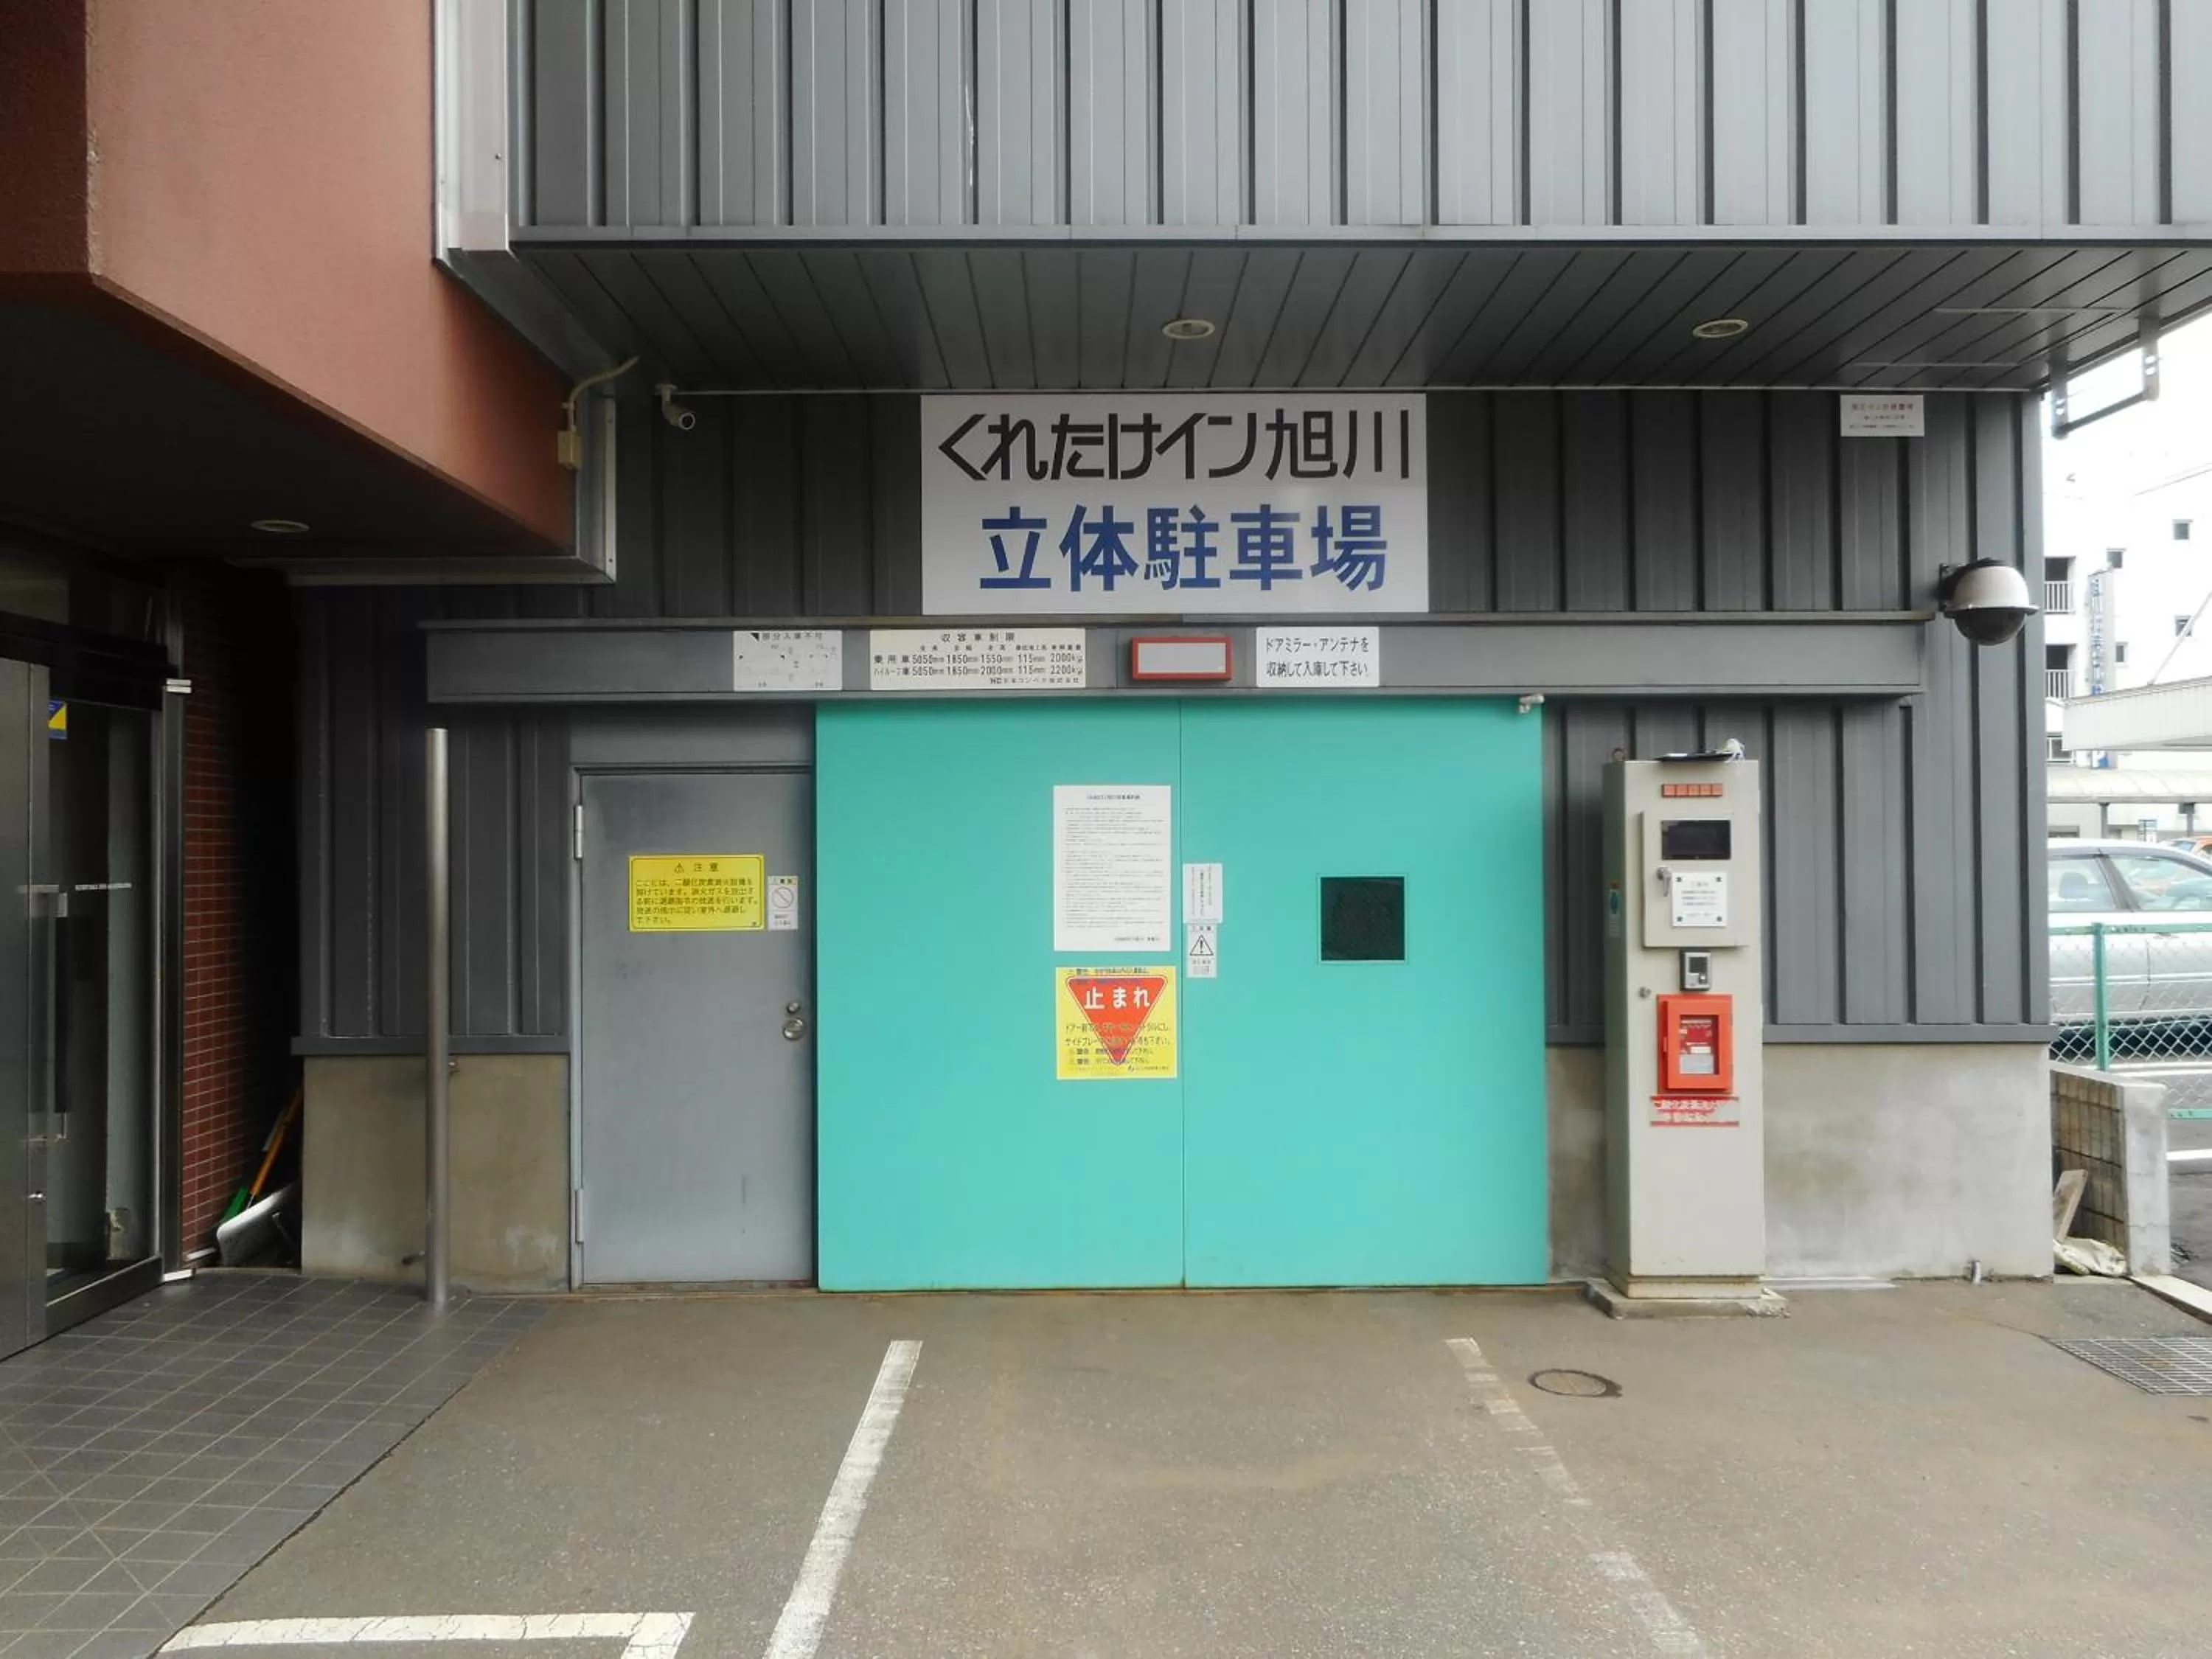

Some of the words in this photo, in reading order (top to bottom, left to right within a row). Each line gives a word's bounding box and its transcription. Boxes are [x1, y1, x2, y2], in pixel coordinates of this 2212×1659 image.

[938, 408, 1410, 480] くれたけイン旭川
[979, 504, 1388, 591] 立体駐車場
[1266, 637, 1368, 653] ドアミラー・アンテナを
[1084, 986, 1150, 1009] 止まれ
